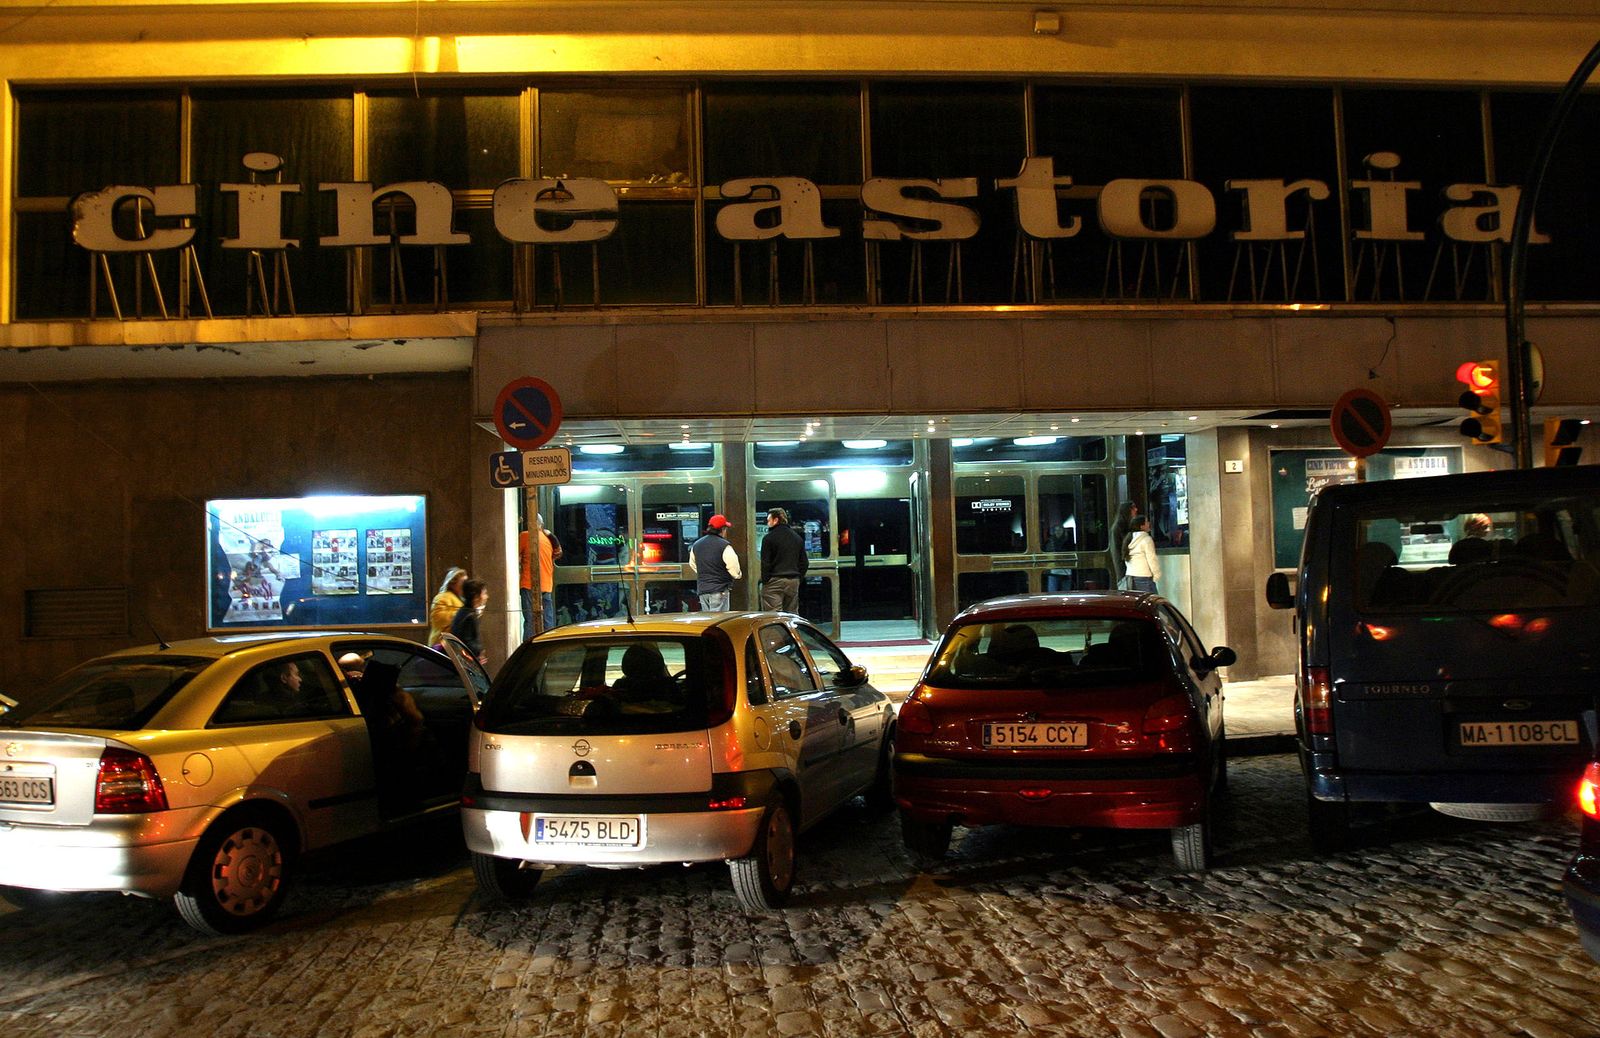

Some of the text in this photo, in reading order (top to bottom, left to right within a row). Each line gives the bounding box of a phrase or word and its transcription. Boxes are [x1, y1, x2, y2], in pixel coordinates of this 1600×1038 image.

[71, 151, 1552, 252] cine astoria
[528, 455, 563, 465] RESERVADO
[1408, 457, 1446, 469] ASTORIA
[526, 468, 567, 479] MINUSVALIDOS
[1364, 684, 1431, 694] TOURNEO
[996, 725, 1079, 744] 5154 CCY
[1461, 723, 1577, 744] MA-1108-CL
[22, 781, 48, 799] CCS
[548, 820, 630, 840] 5475 BLD
